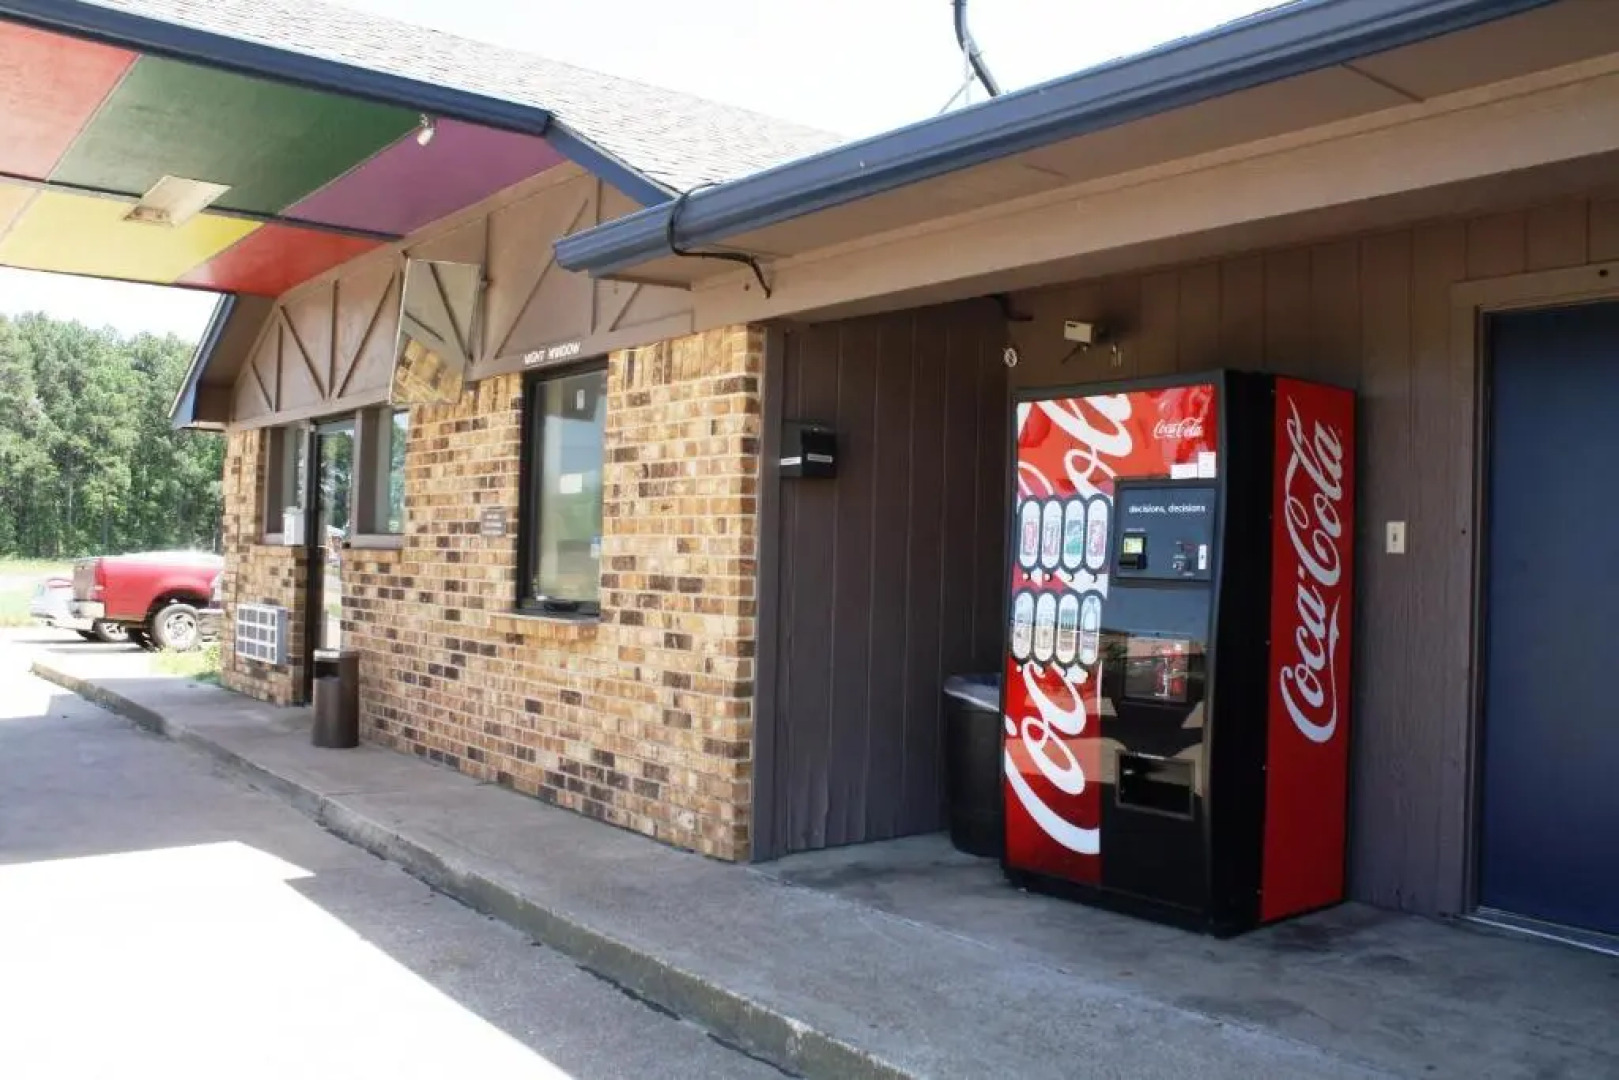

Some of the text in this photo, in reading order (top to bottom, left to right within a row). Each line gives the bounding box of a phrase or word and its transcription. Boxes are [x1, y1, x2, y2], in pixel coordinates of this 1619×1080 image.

[1153, 416, 1204, 439] Coca-Cola
[1168, 503, 1206, 514] decisions
[1280, 394, 1343, 743] Coca-Cola
